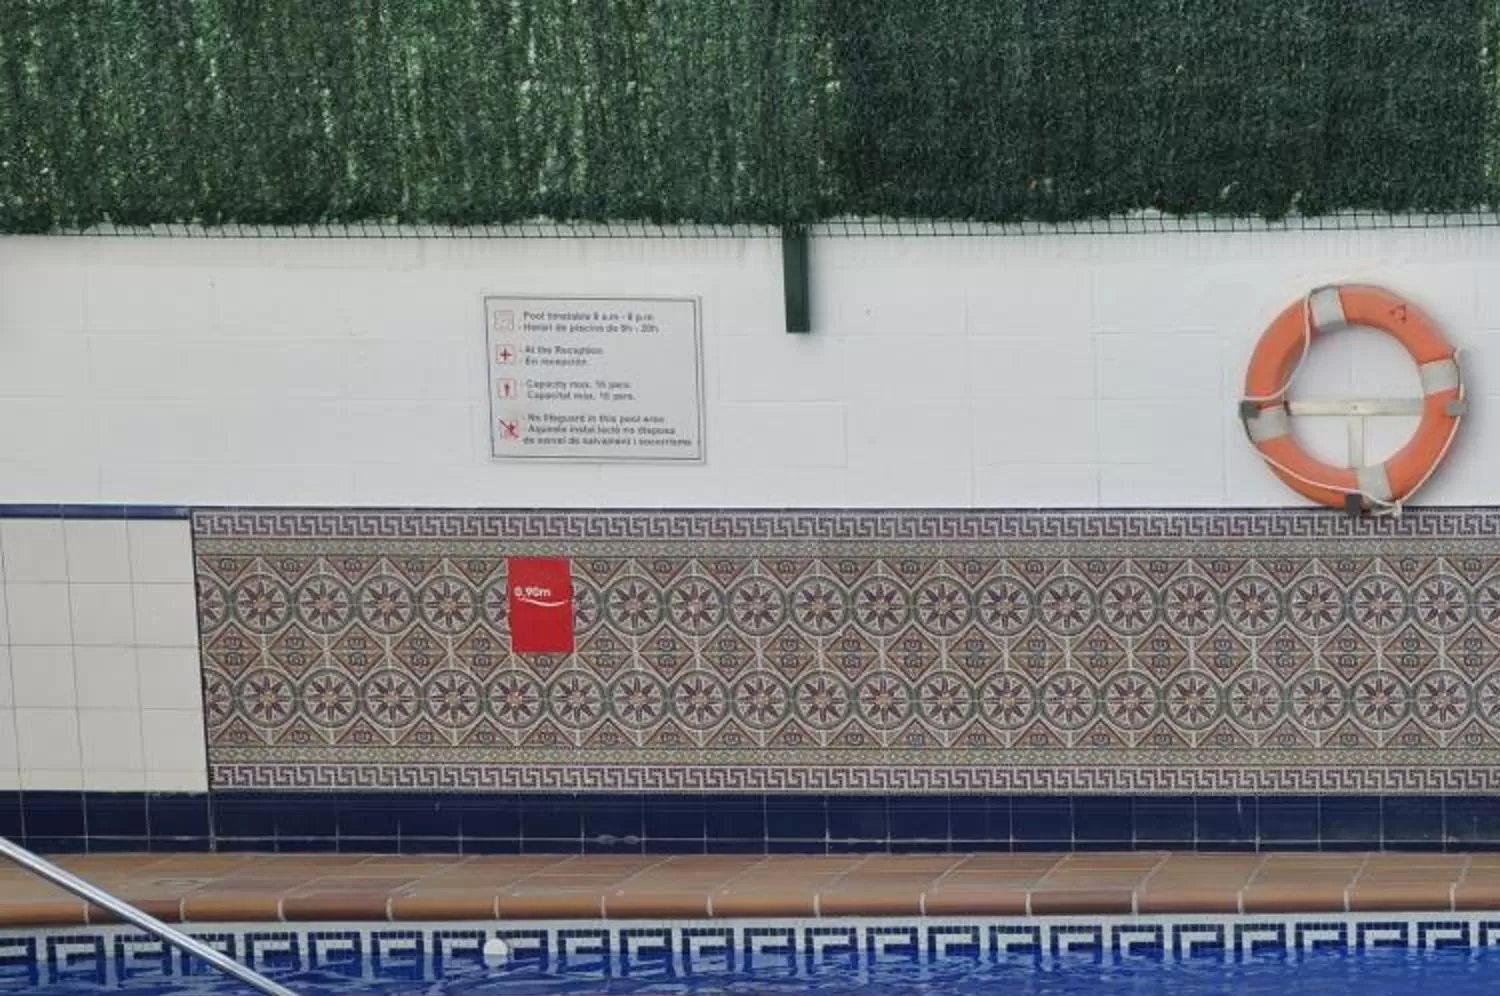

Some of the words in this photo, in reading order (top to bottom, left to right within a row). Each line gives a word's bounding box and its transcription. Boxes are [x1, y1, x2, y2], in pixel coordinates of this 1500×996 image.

[523, 311, 544, 321] Pool
[547, 311, 591, 321] timetable
[537, 346, 552, 355] the
[526, 380, 567, 391] Capacity
[587, 413, 597, 423] in
[599, 413, 617, 423] this
[619, 414, 641, 424] pool
